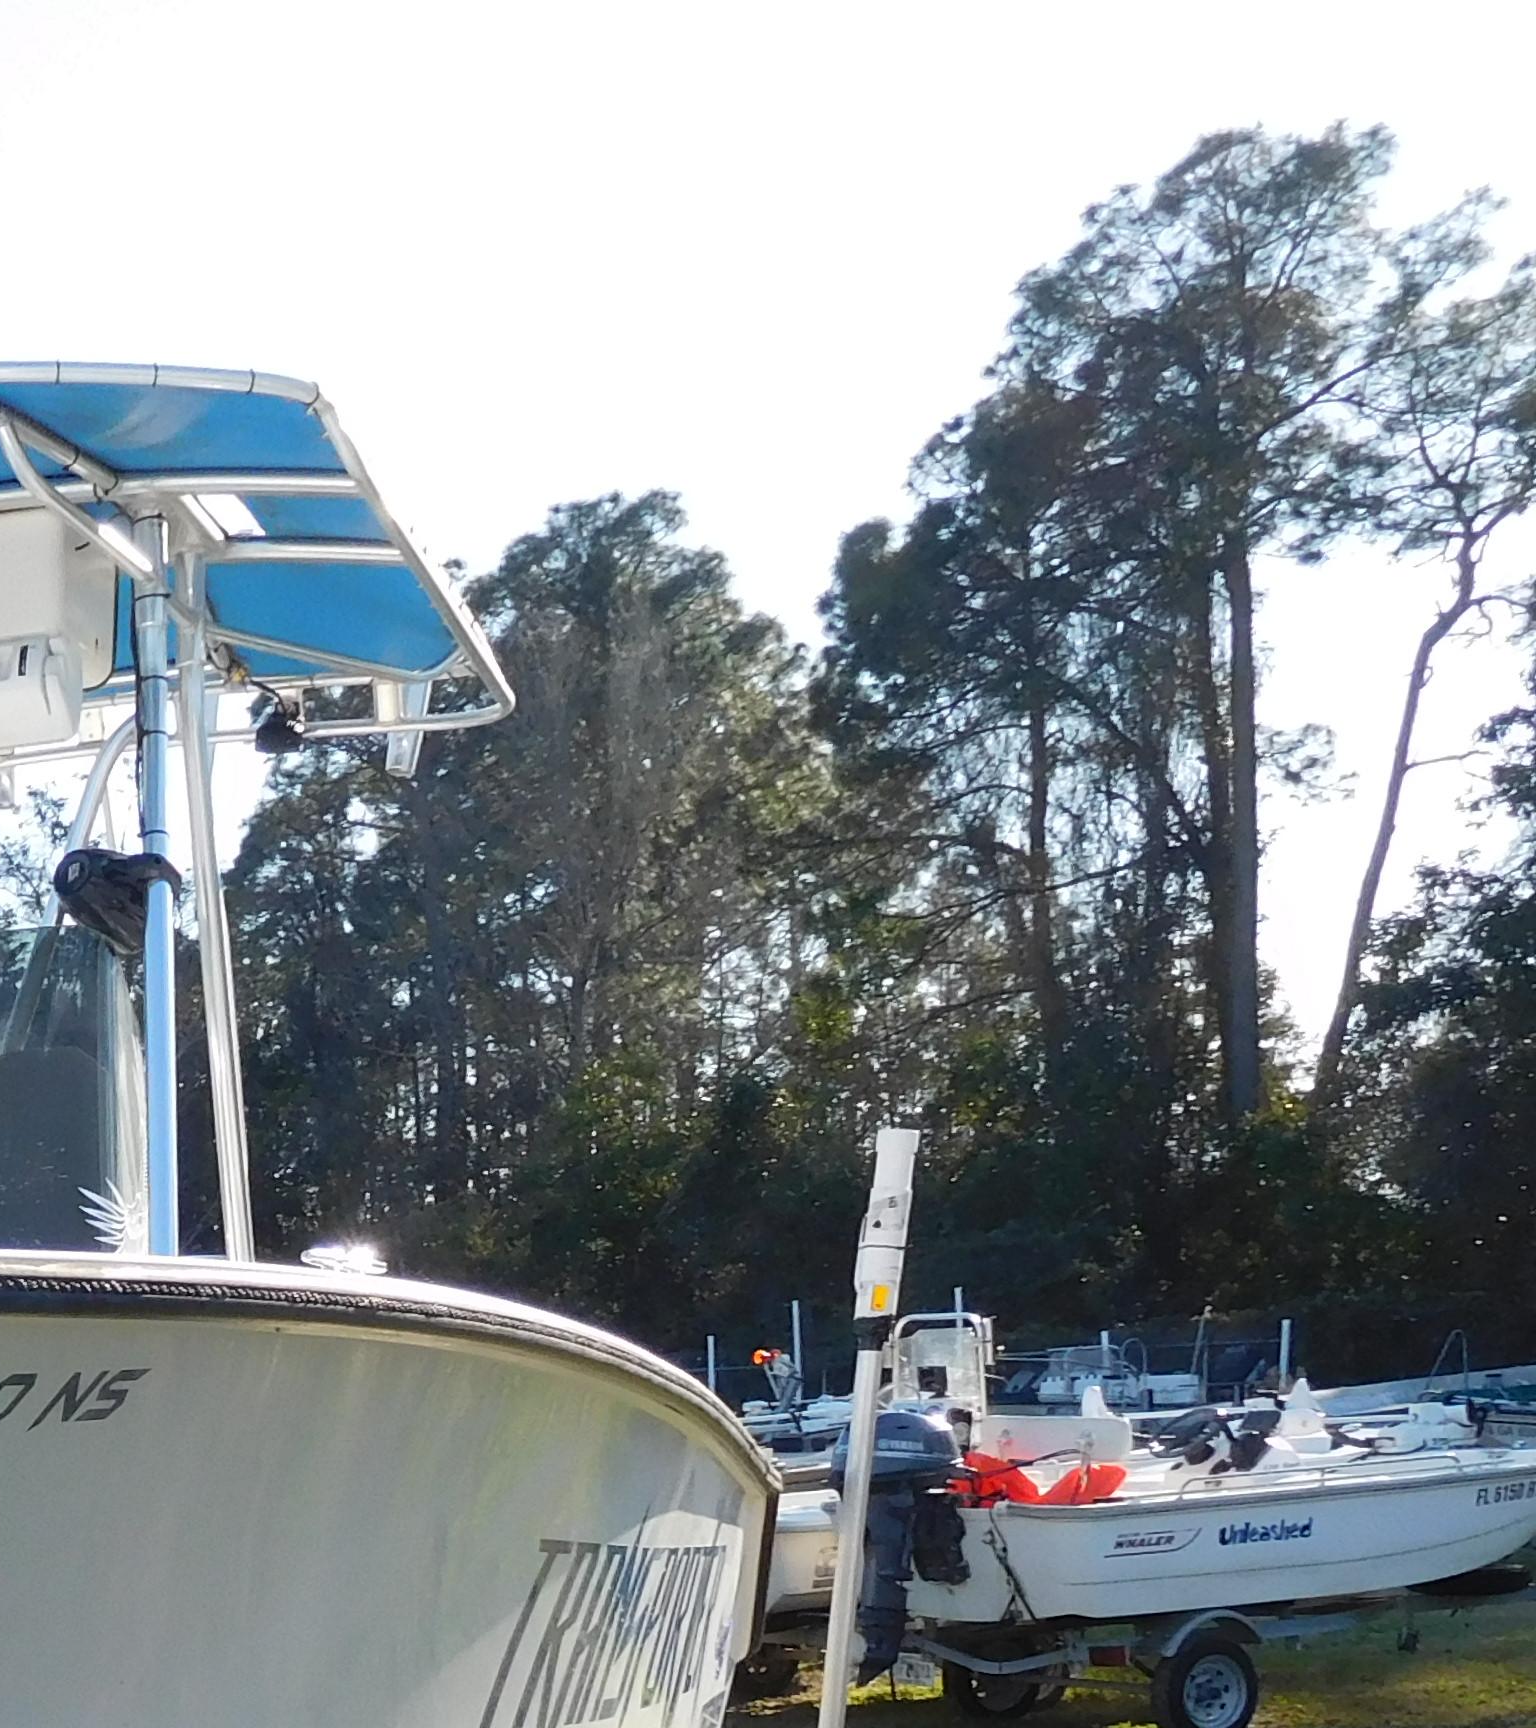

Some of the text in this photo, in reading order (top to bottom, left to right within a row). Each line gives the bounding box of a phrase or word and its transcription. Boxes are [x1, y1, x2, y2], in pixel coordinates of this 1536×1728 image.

[26, 1367, 151, 1432] NS
[1476, 1488, 1490, 1507] FL
[1113, 1535, 1176, 1550] WHALER
[1218, 1516, 1314, 1546] Unleashed
